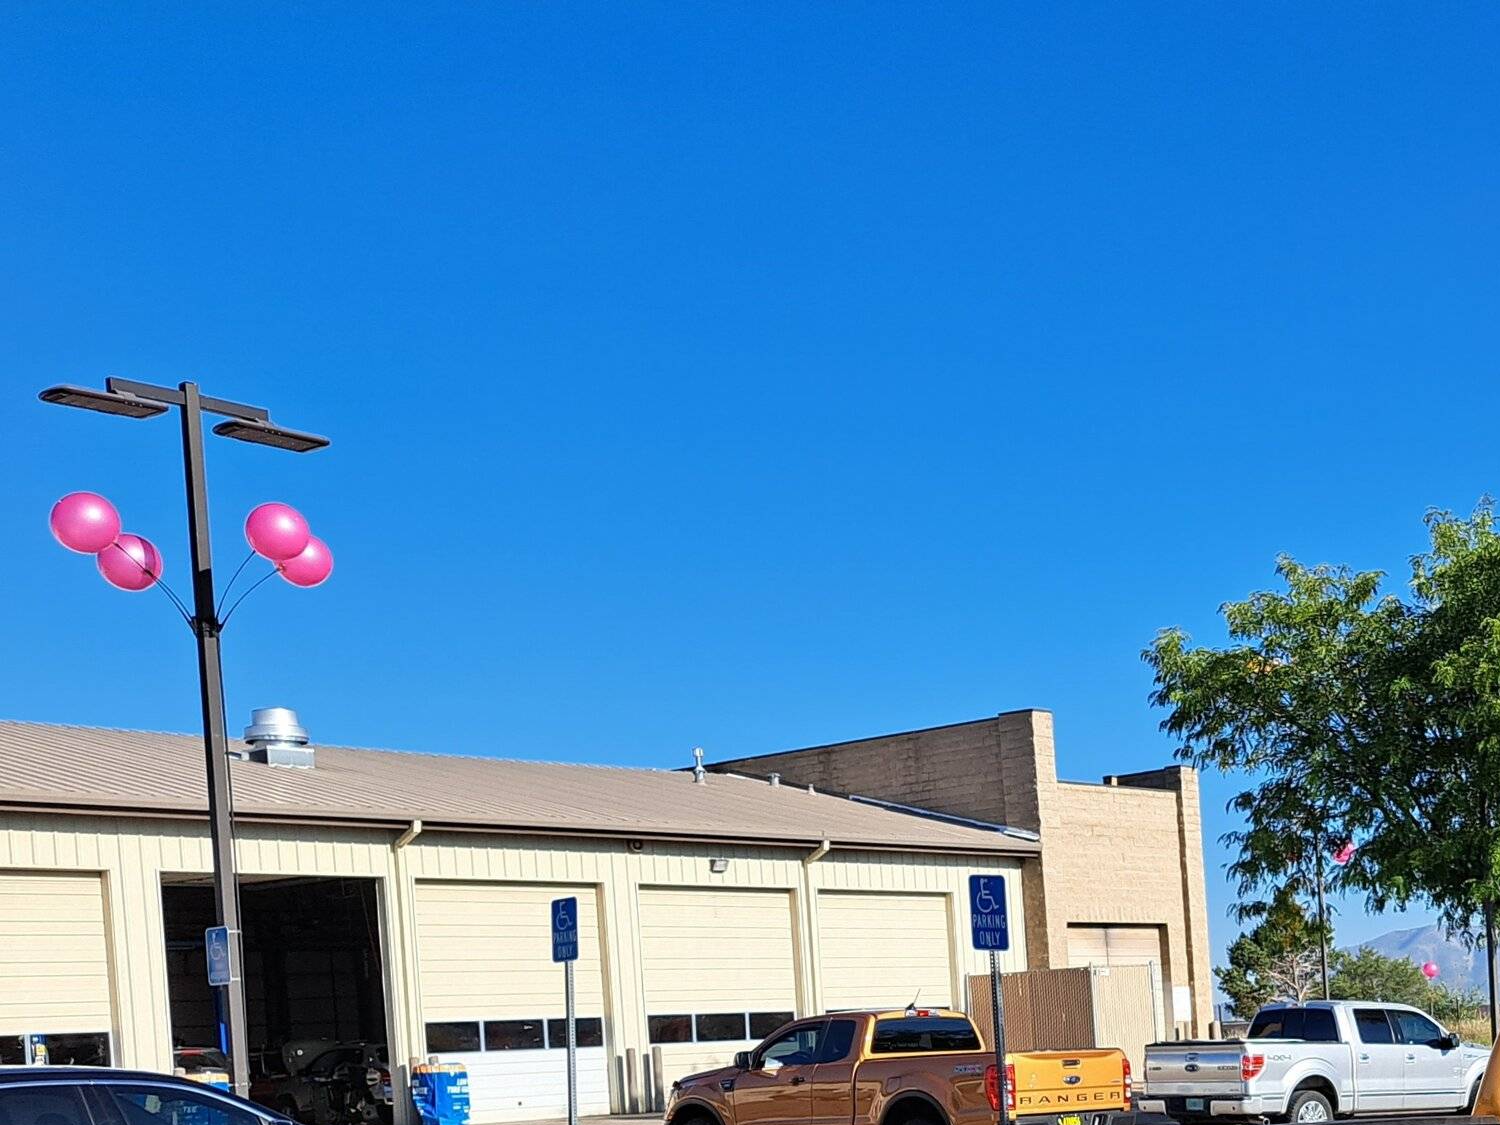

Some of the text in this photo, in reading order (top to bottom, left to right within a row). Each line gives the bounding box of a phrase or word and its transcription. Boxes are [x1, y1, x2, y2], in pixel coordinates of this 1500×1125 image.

[972, 913, 1006, 929] PARKING
[979, 931, 1001, 947] ONLY
[1019, 1090, 1121, 1105] RANGER
